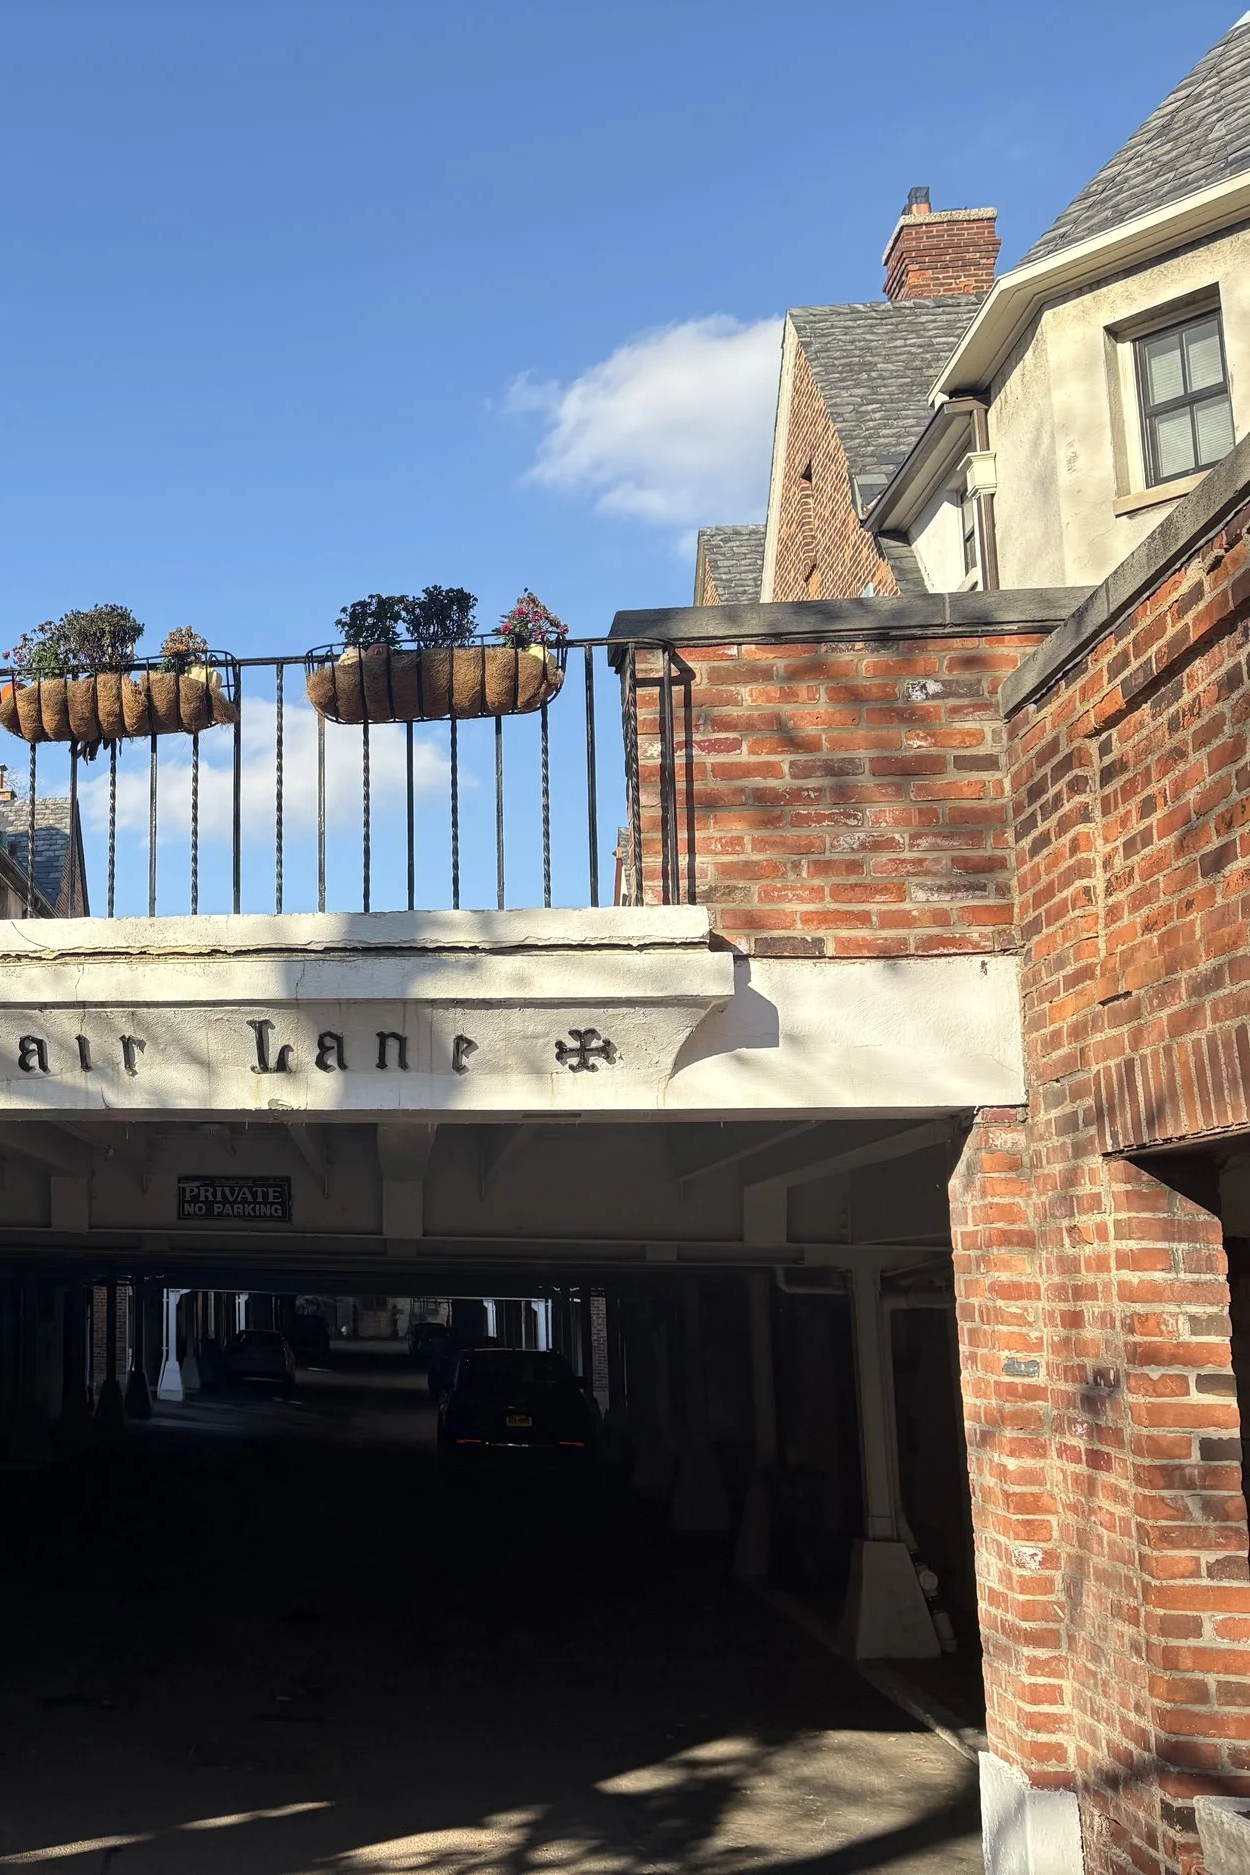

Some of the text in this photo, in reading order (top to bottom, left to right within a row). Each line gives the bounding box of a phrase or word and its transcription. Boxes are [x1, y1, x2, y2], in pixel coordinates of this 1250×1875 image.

[246, 1018, 479, 1076] Lane
[184, 1186, 282, 1202] PRIVATE
[184, 1202, 282, 1217] NO PARKING
